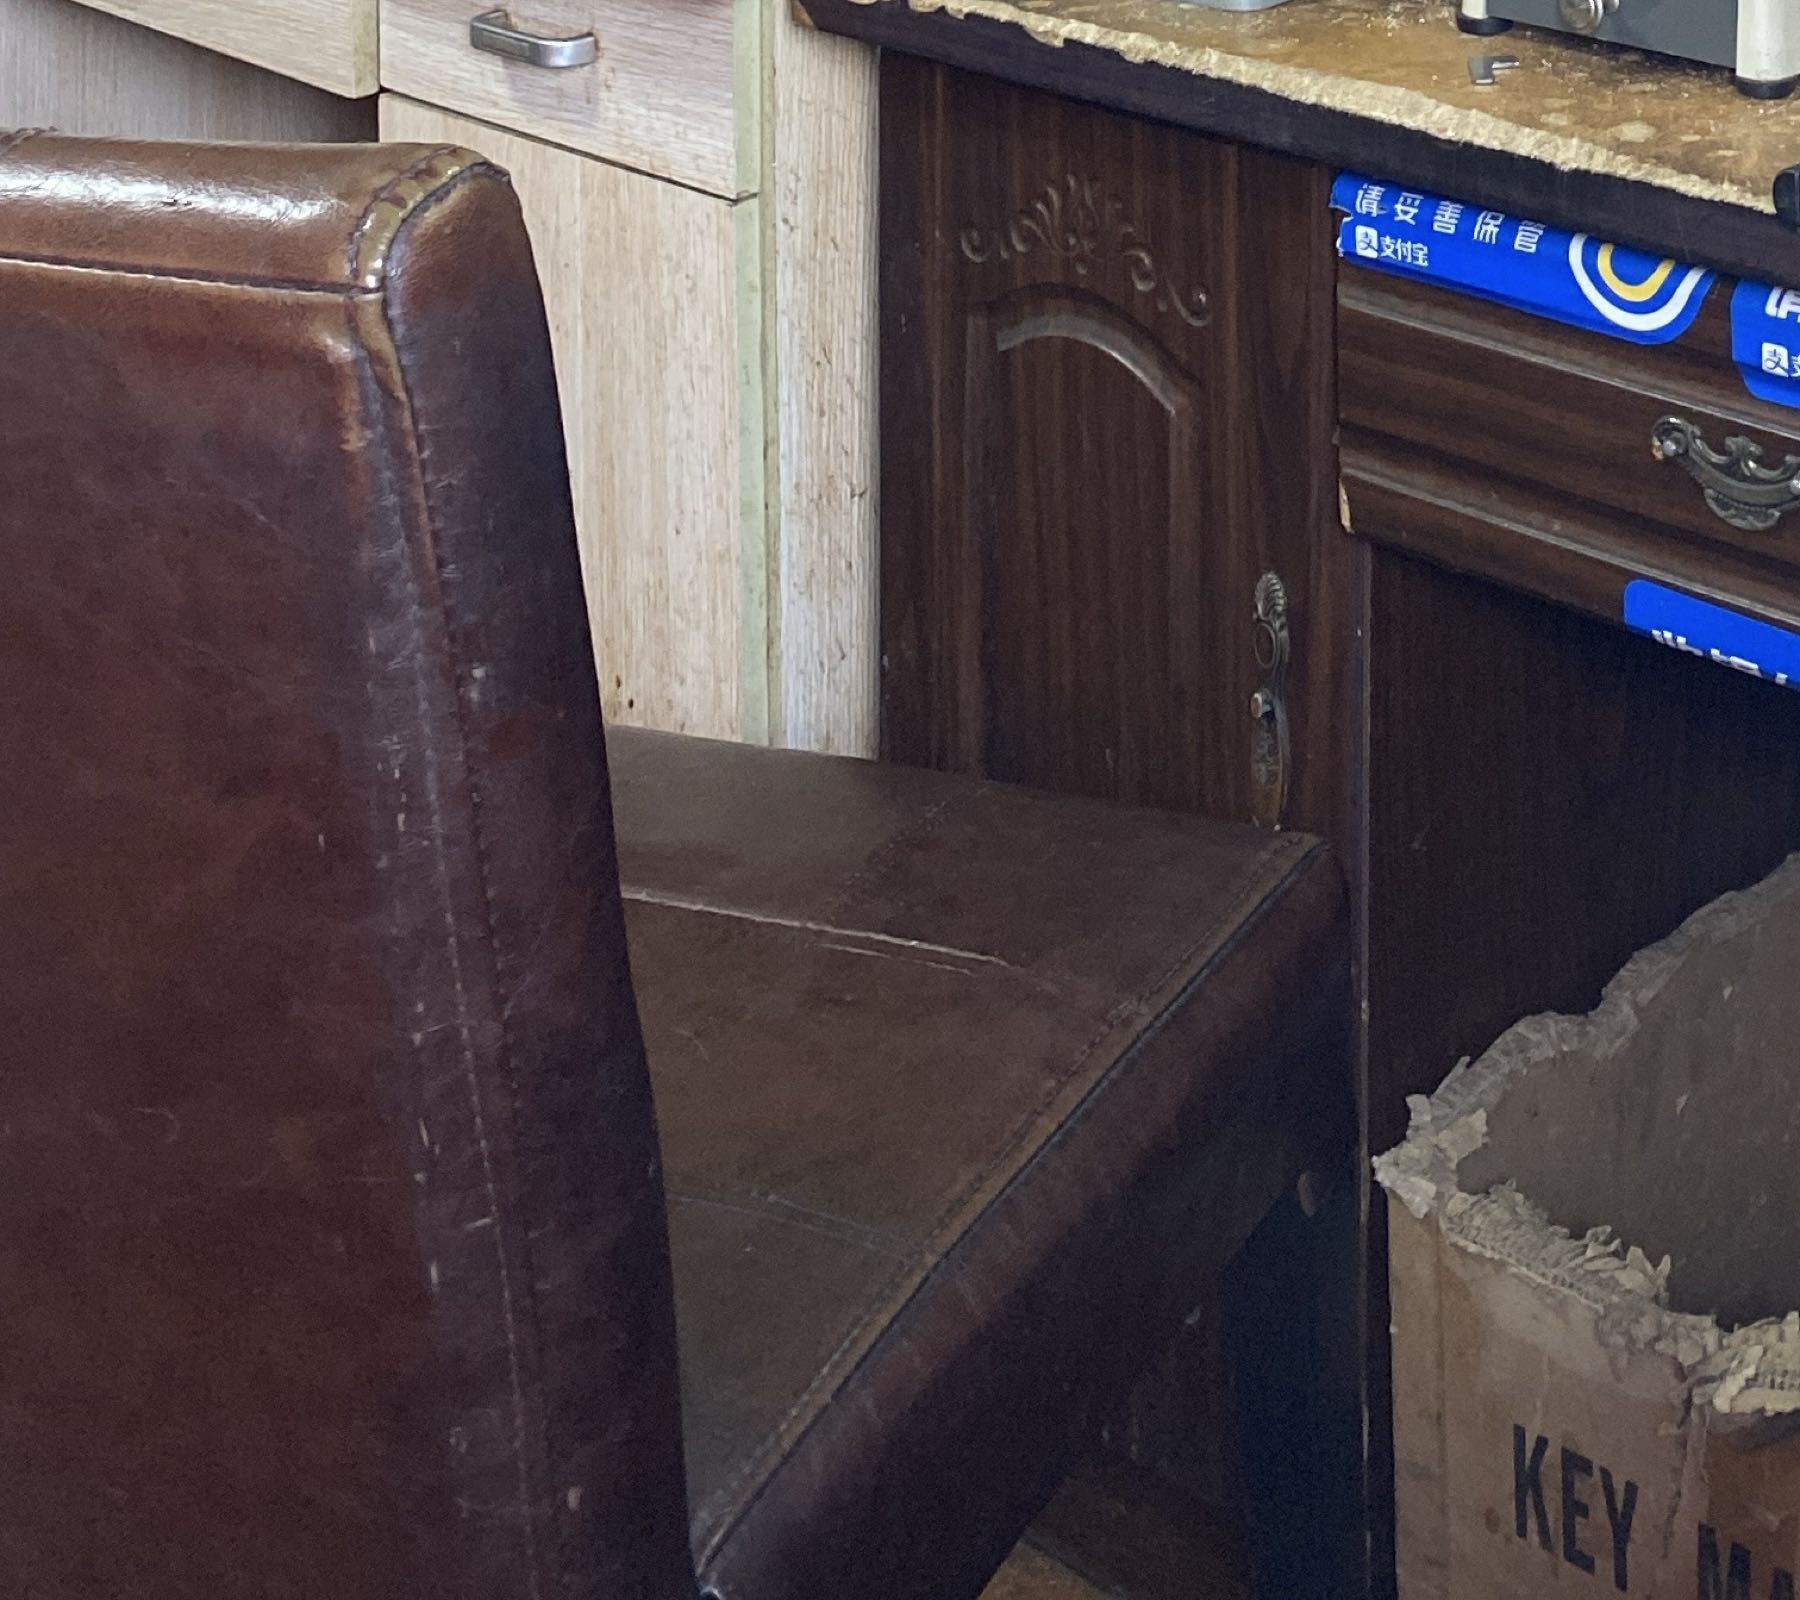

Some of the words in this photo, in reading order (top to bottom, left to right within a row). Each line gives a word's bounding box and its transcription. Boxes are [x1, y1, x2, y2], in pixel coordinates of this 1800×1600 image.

[1355, 183, 1548, 254] 请妥善保管
[1380, 234, 1430, 267] 支付宝
[1511, 1422, 1639, 1594] KEY
